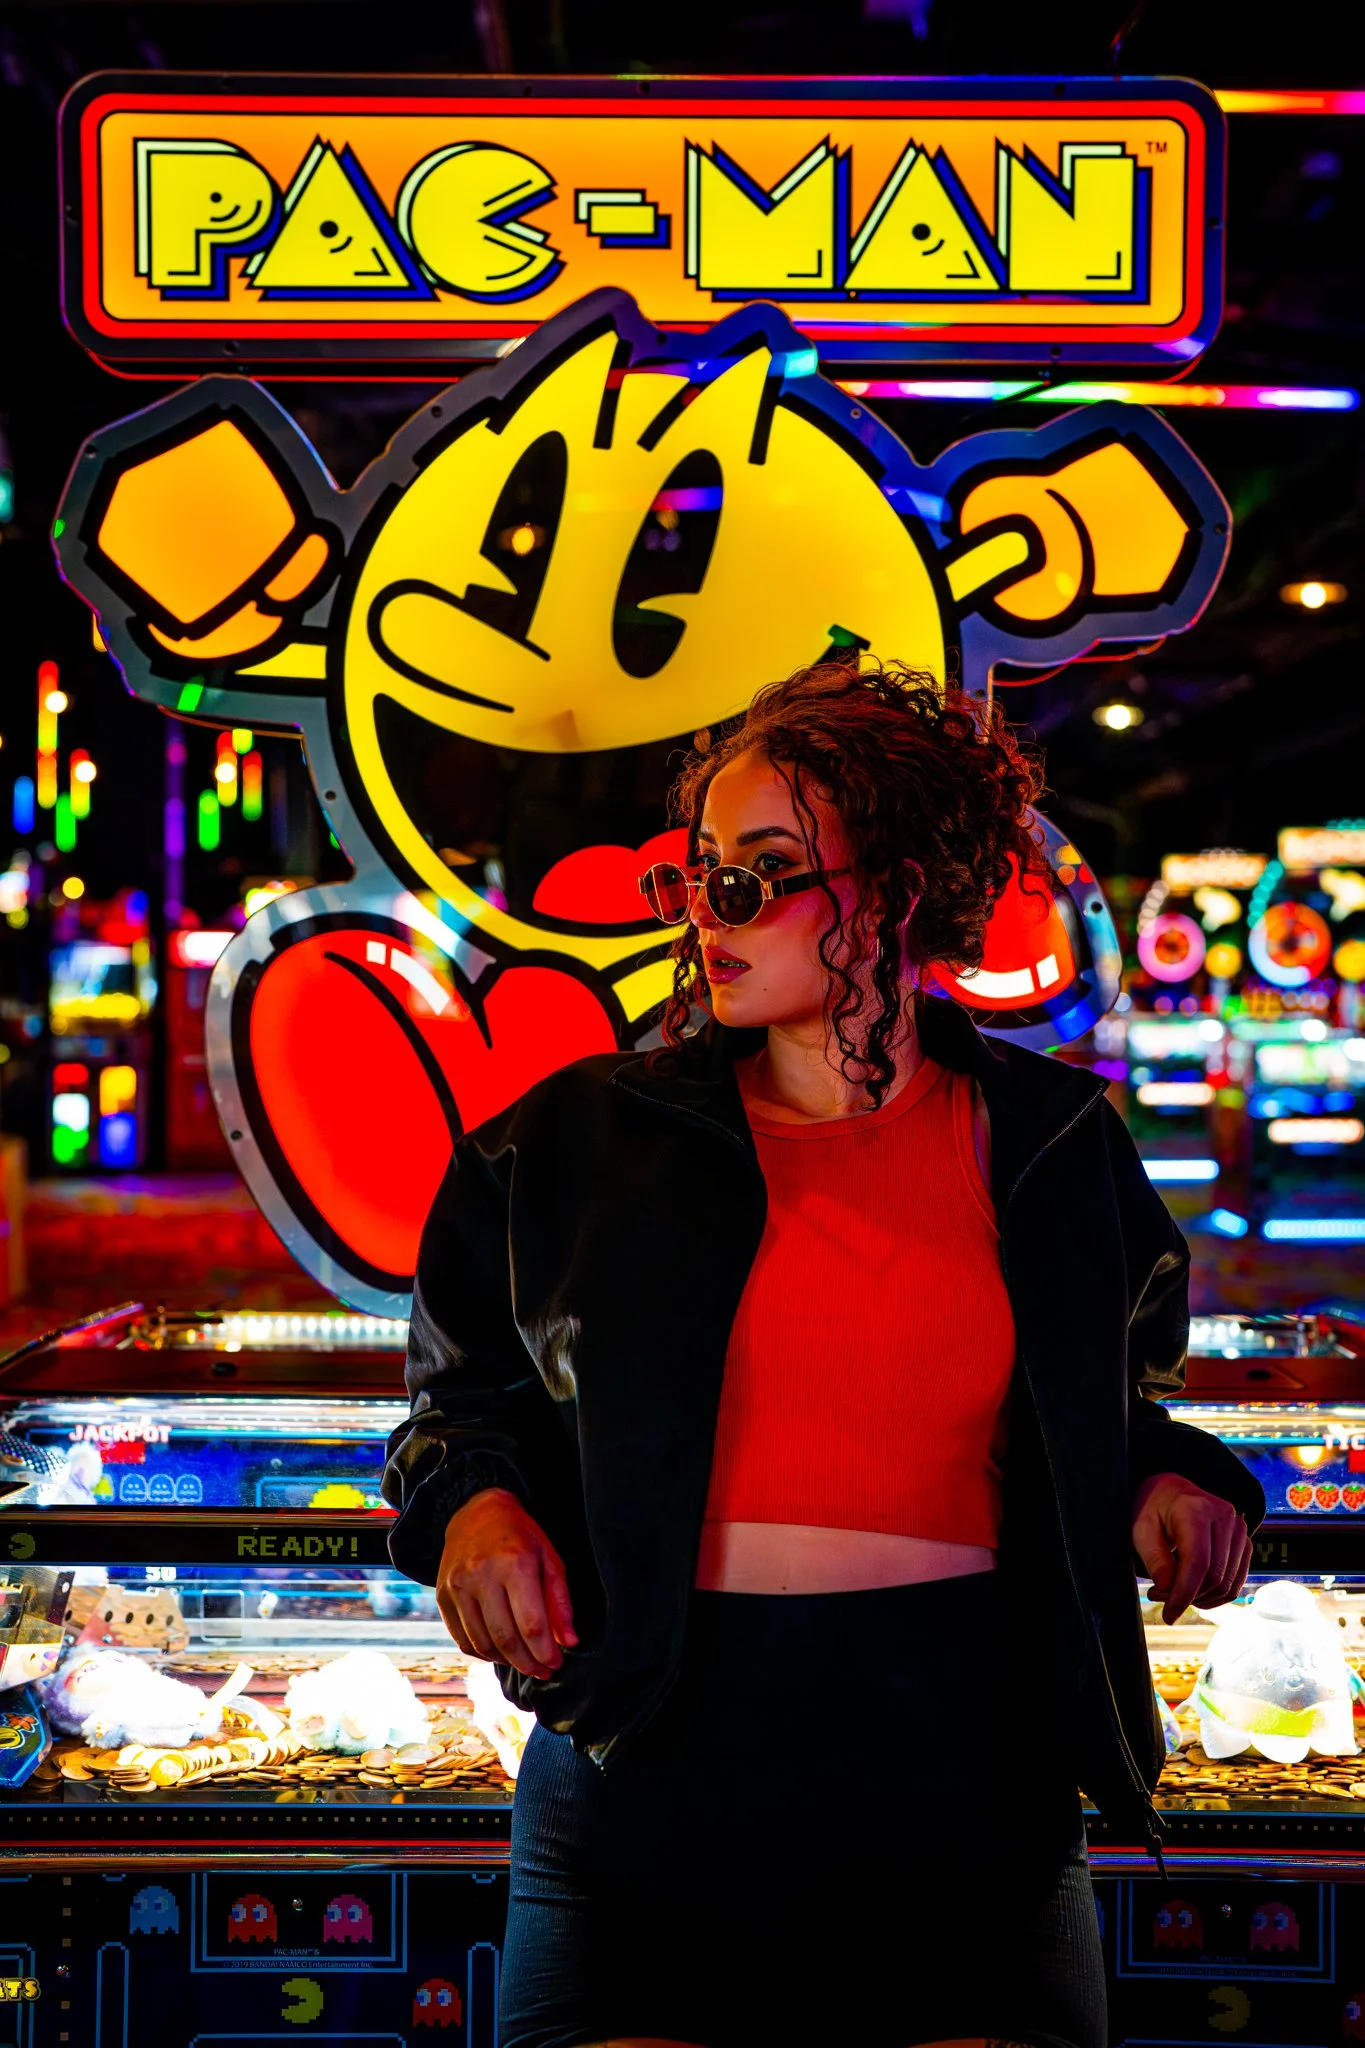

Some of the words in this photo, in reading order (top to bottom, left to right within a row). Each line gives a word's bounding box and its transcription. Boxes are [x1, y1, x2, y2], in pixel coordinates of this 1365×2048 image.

[134, 134, 1153, 305] PAC-MAN
[68, 1424, 172, 1443] JACKPOT
[238, 1536, 358, 1557] READY!
[360, 1961, 374, 1969] Inc.
